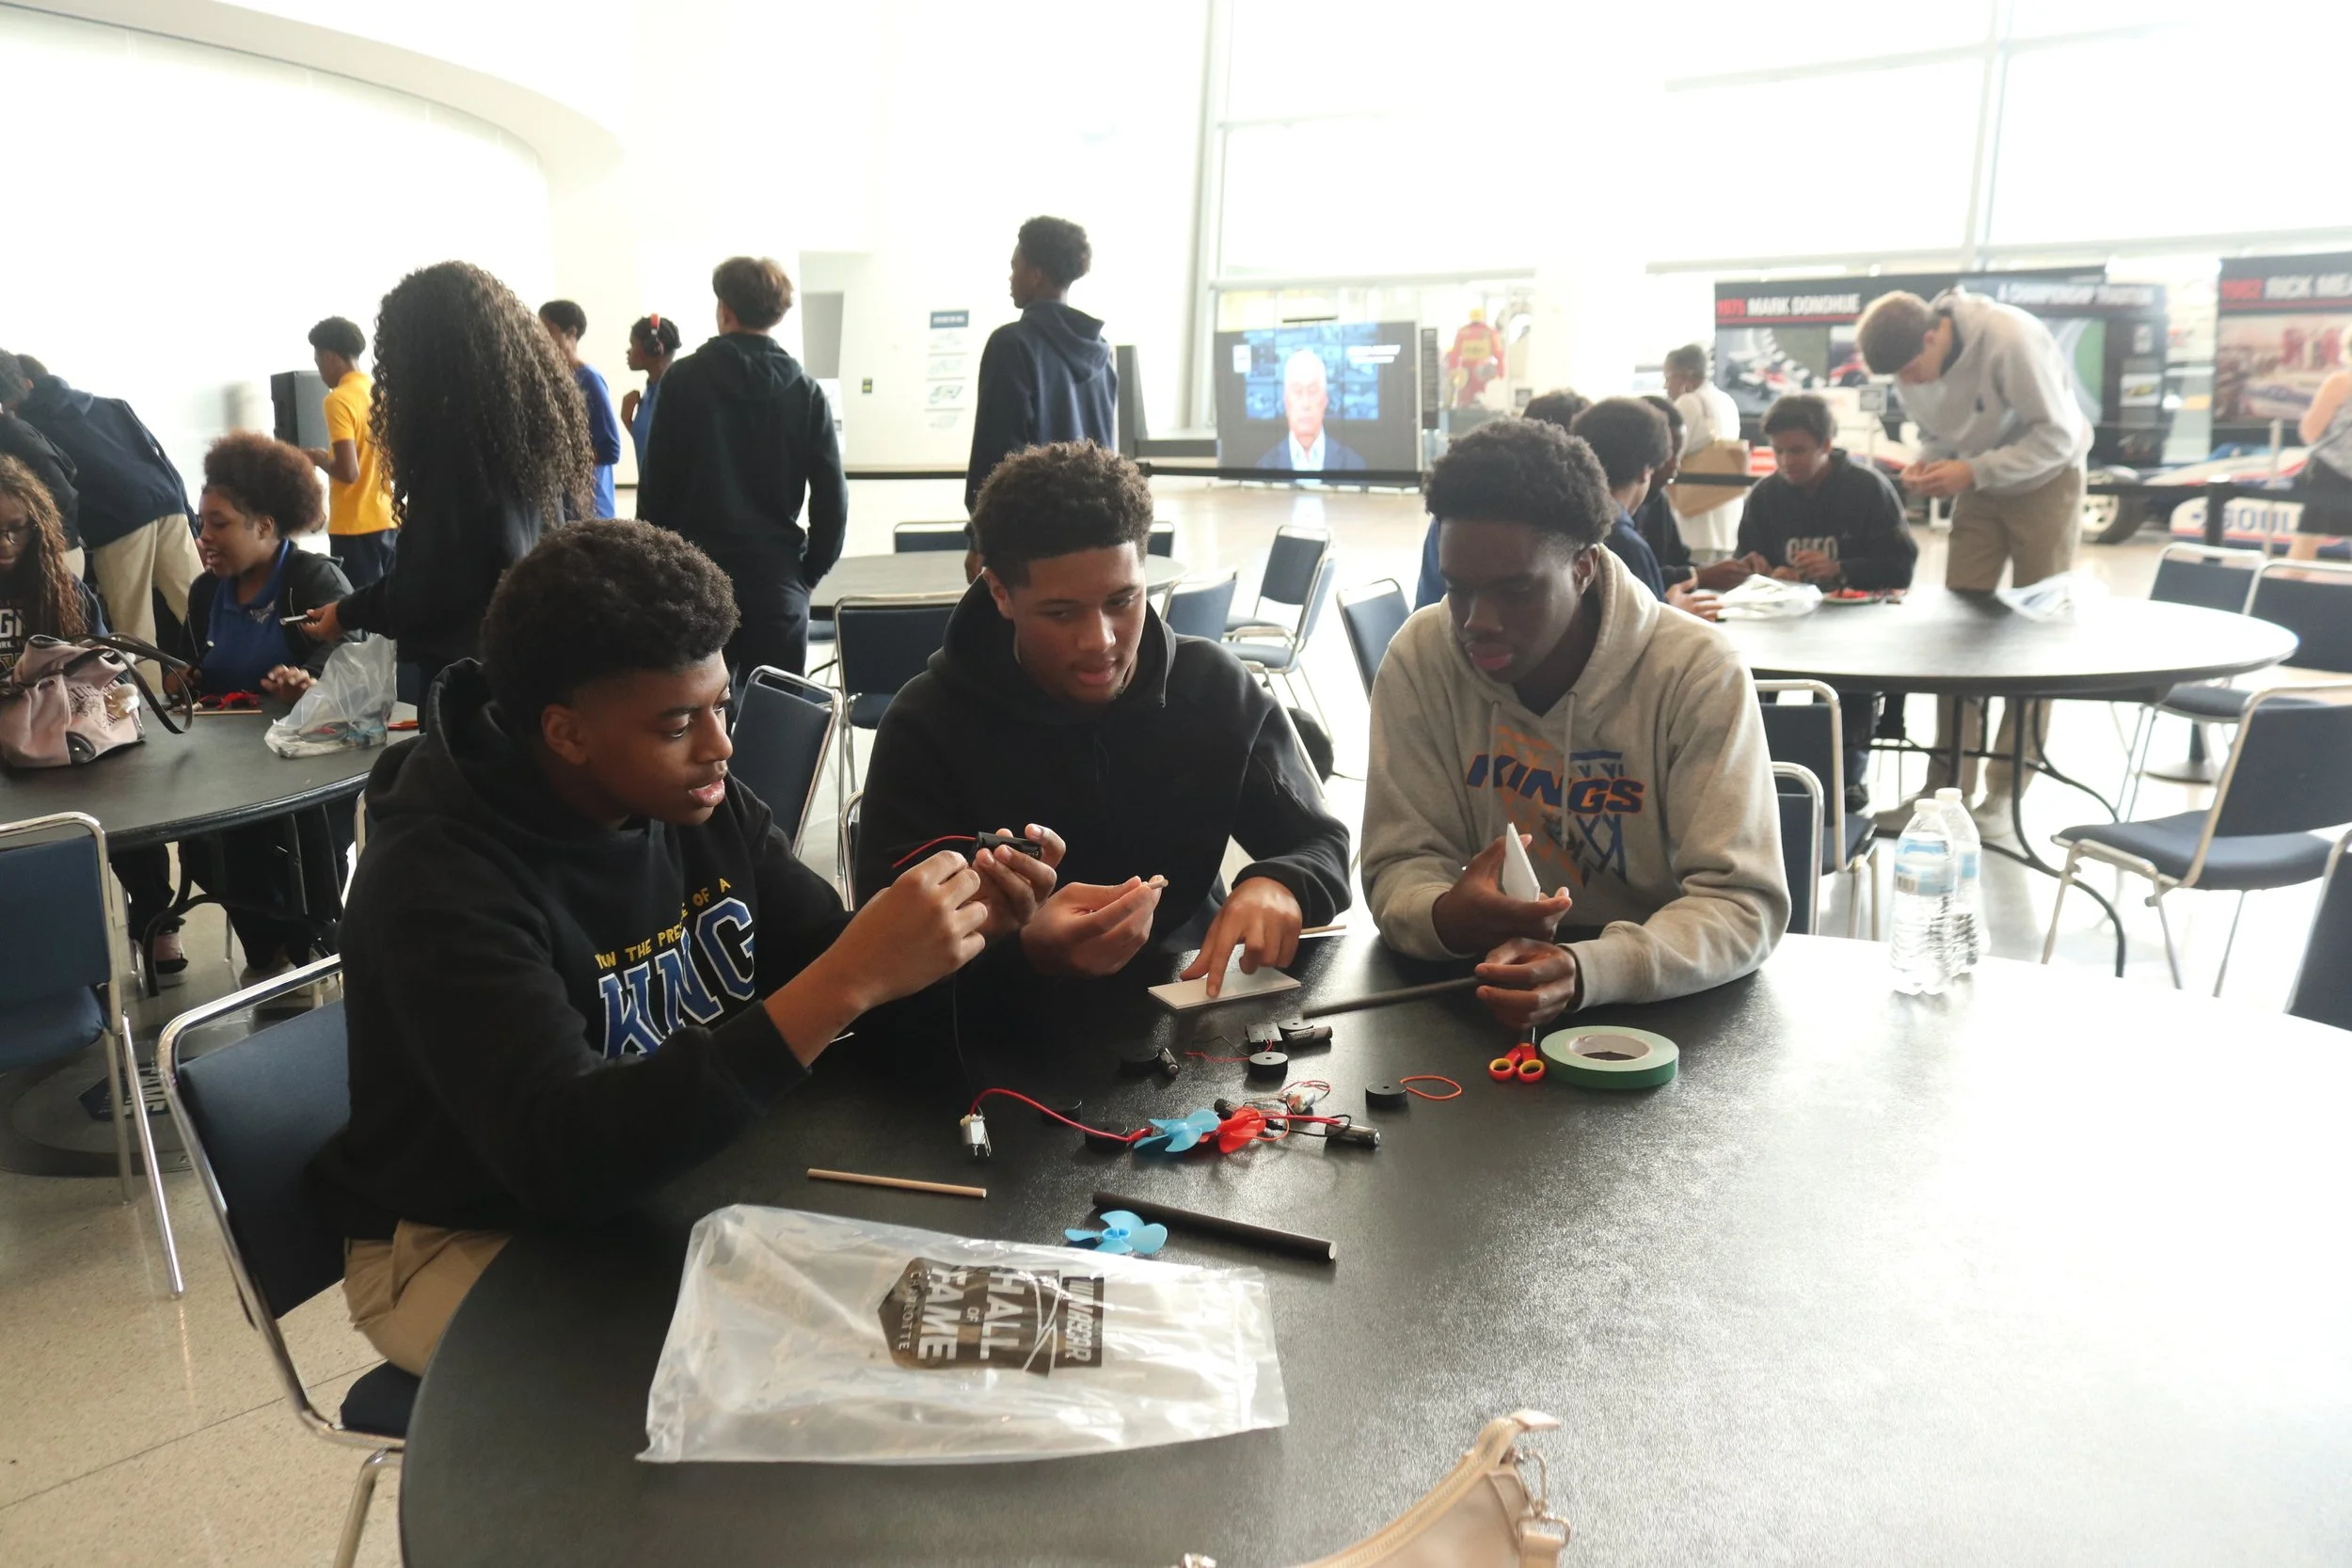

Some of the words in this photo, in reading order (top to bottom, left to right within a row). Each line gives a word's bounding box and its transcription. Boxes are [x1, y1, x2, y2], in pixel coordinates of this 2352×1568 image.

[1747, 295, 1790, 316] MARK
[1466, 754, 1645, 815] KINGS
[625, 939, 652, 962] THE
[692, 887, 710, 907] OF
[719, 878, 731, 893] A
[898, 1271, 923, 1350] CHARLOTTE
[917, 1267, 968, 1360] FAME
[966, 1306, 979, 1323] OF
[979, 1272, 1025, 1359] HALL
[1065, 1295, 1094, 1362] NASCAR
